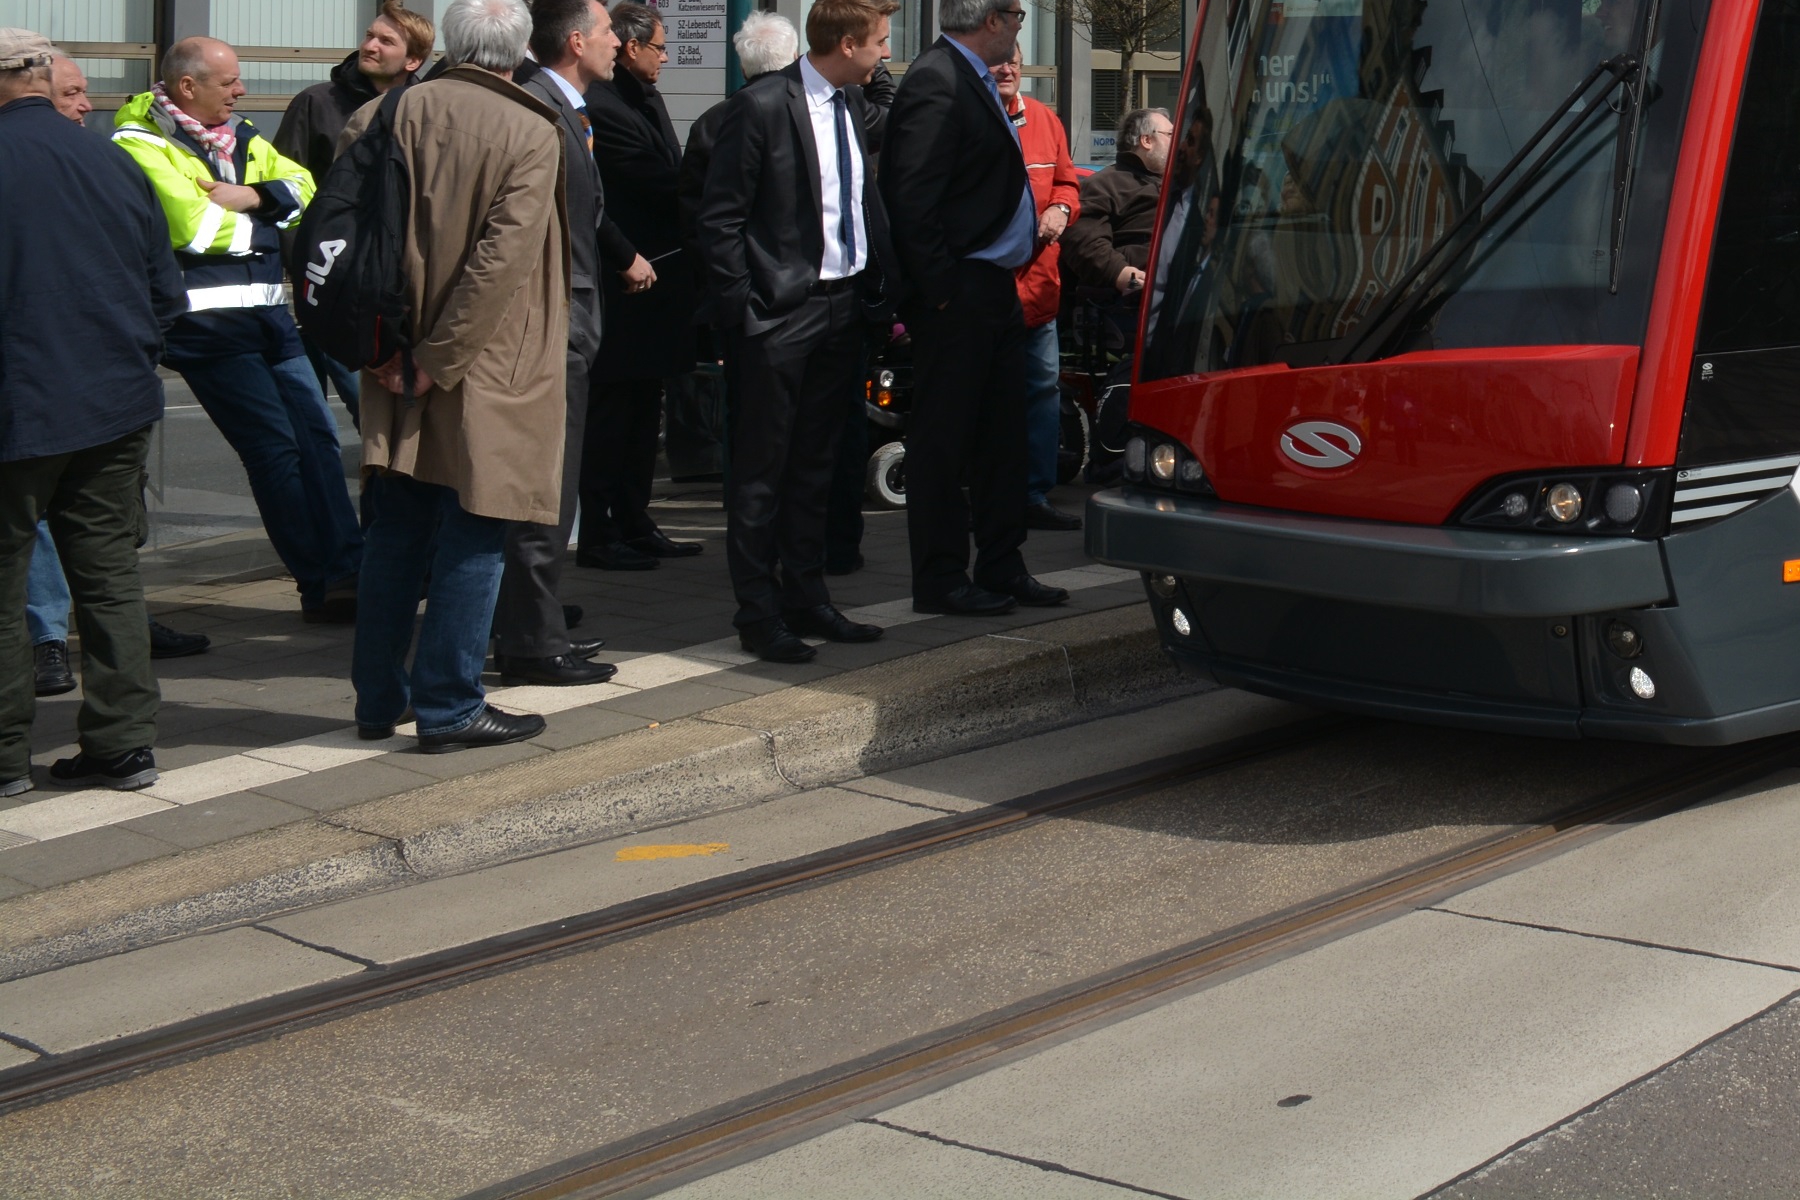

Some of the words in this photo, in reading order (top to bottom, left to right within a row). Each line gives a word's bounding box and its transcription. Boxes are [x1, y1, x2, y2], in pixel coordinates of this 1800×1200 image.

[658, 0, 669, 8] 603
[678, 20, 722, 30] SZ-Lebenstedt,
[677, 30, 708, 39] Hallenbad
[677, 55, 703, 65] Bahnhof
[303, 239, 347, 307] FILA
